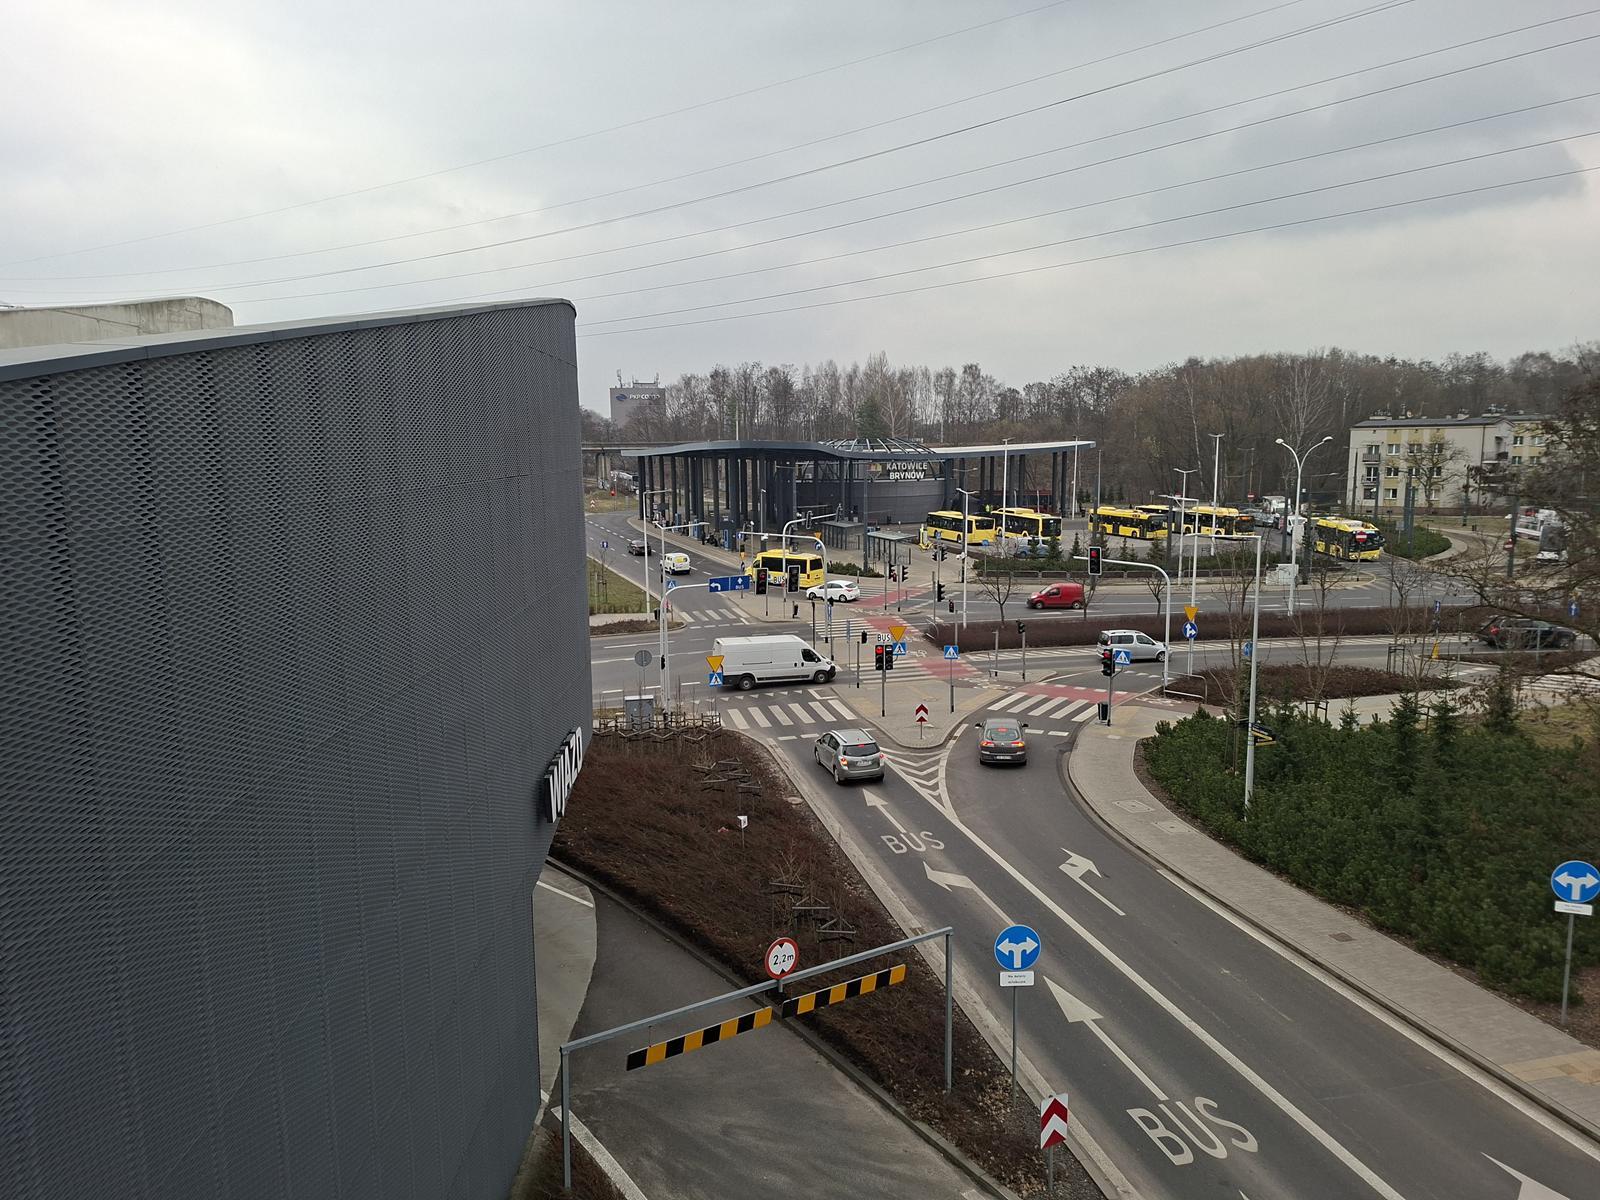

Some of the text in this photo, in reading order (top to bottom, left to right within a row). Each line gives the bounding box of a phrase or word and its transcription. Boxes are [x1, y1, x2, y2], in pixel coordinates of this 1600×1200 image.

[886, 462, 928, 470] KATOWICE
[889, 470, 925, 480] BRYNÓW
[773, 576, 786, 584] BUS
[877, 633, 891, 642] BUS
[880, 831, 945, 854] BUS
[1126, 1096, 1259, 1166] BUS
